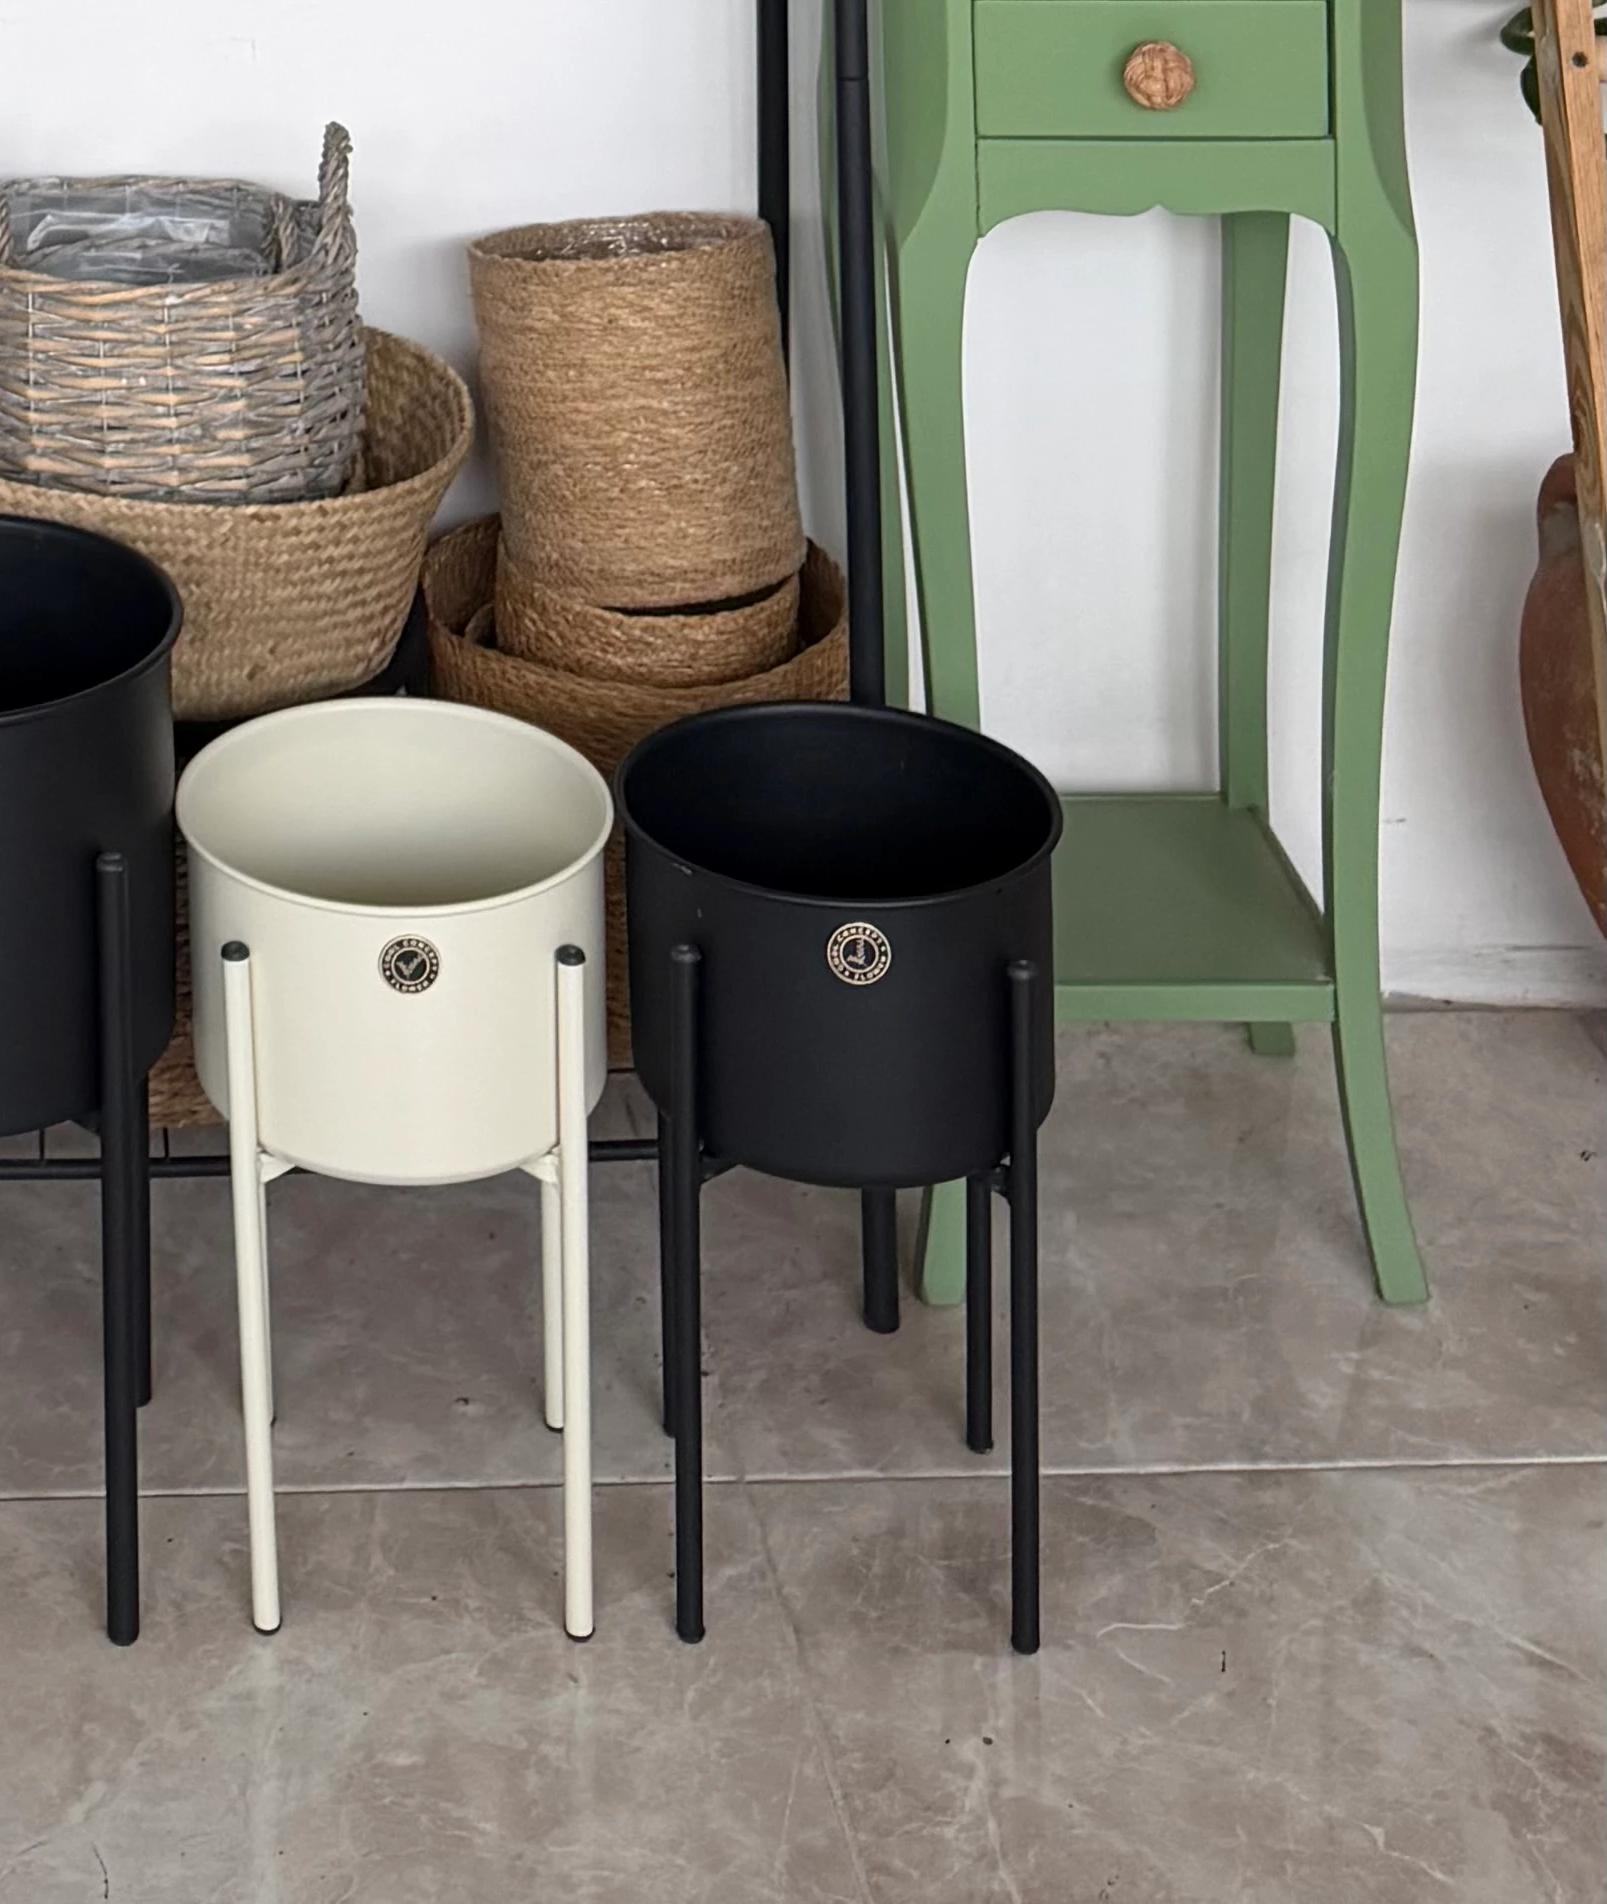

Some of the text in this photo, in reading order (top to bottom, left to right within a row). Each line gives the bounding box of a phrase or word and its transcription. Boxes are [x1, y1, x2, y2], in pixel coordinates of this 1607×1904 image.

[836, 927, 882, 944] CONCEPT
[402, 940, 437, 971] CONCEPT
[854, 955, 886, 980] FLOWER
[390, 978, 429, 992] FLOWER
